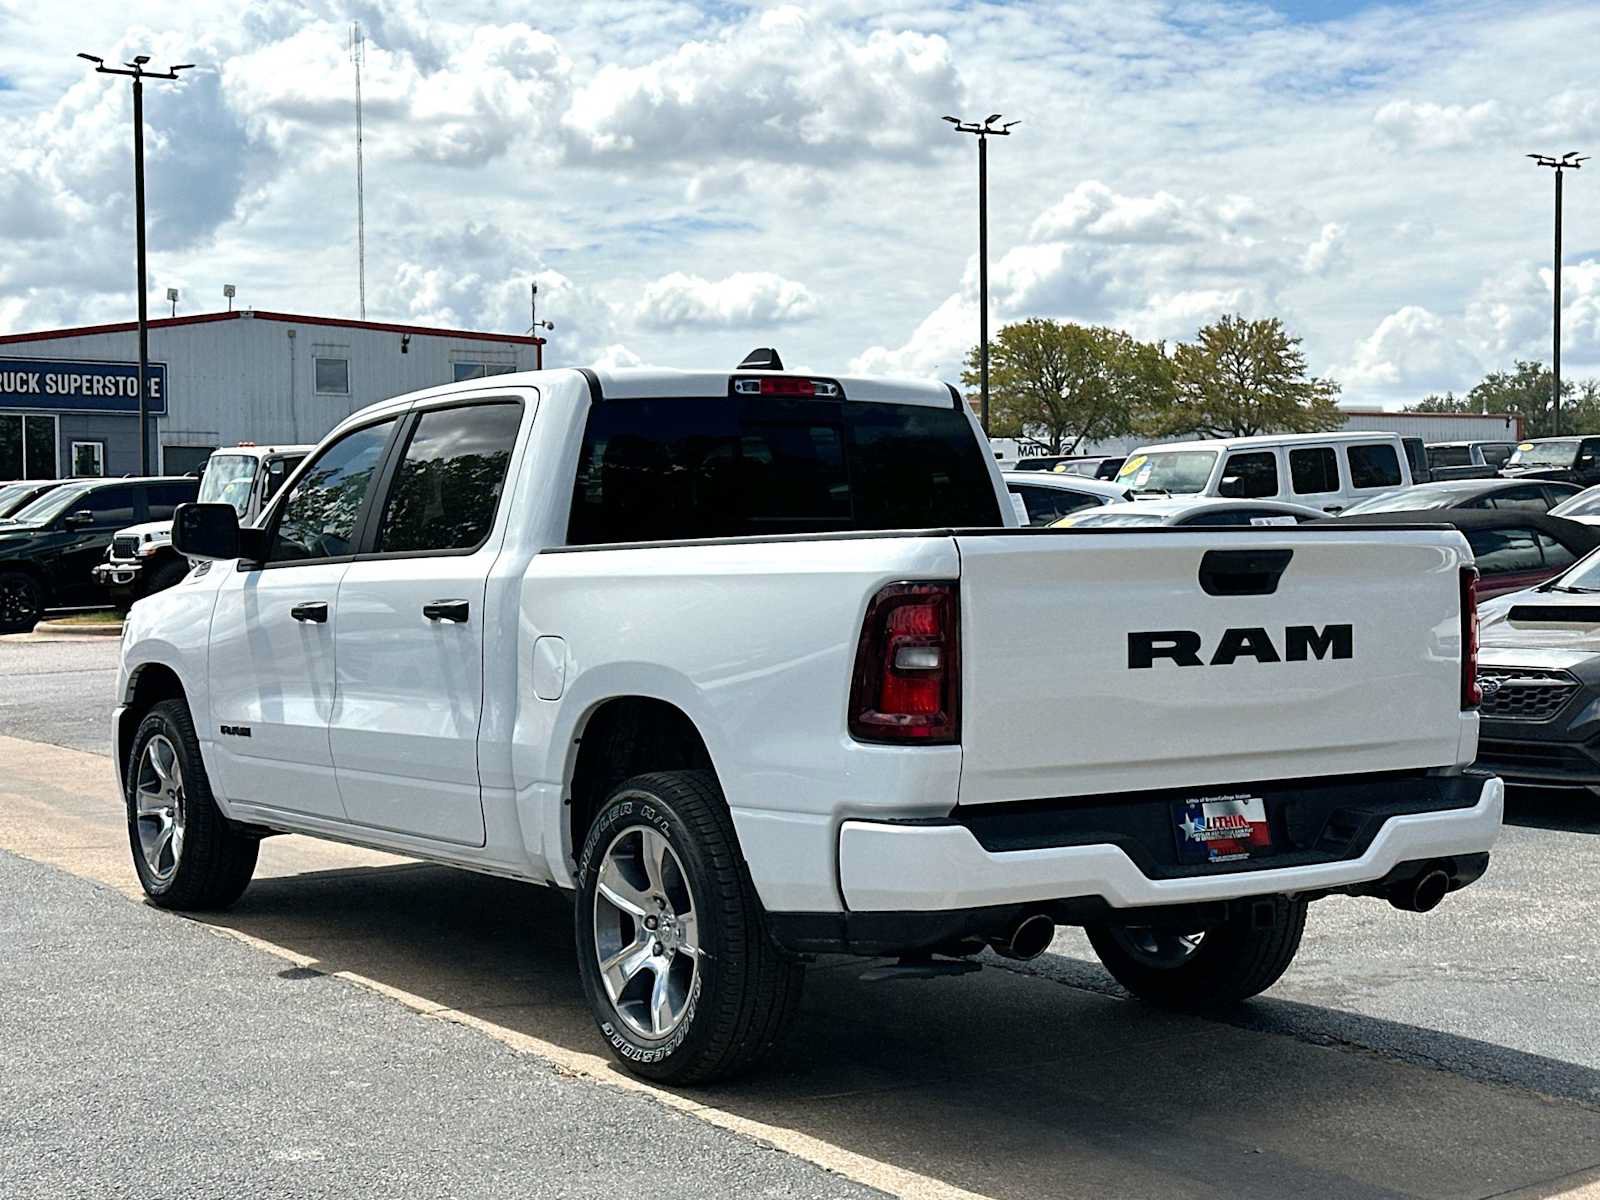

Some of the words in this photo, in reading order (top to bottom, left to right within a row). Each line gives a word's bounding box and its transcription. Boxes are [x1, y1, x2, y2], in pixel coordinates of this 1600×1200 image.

[45, 373, 161, 398] SUPERSTOE
[1128, 624, 1353, 669] RAM
[220, 725, 252, 737] RAM
[1207, 814, 1250, 829] LITHIA
